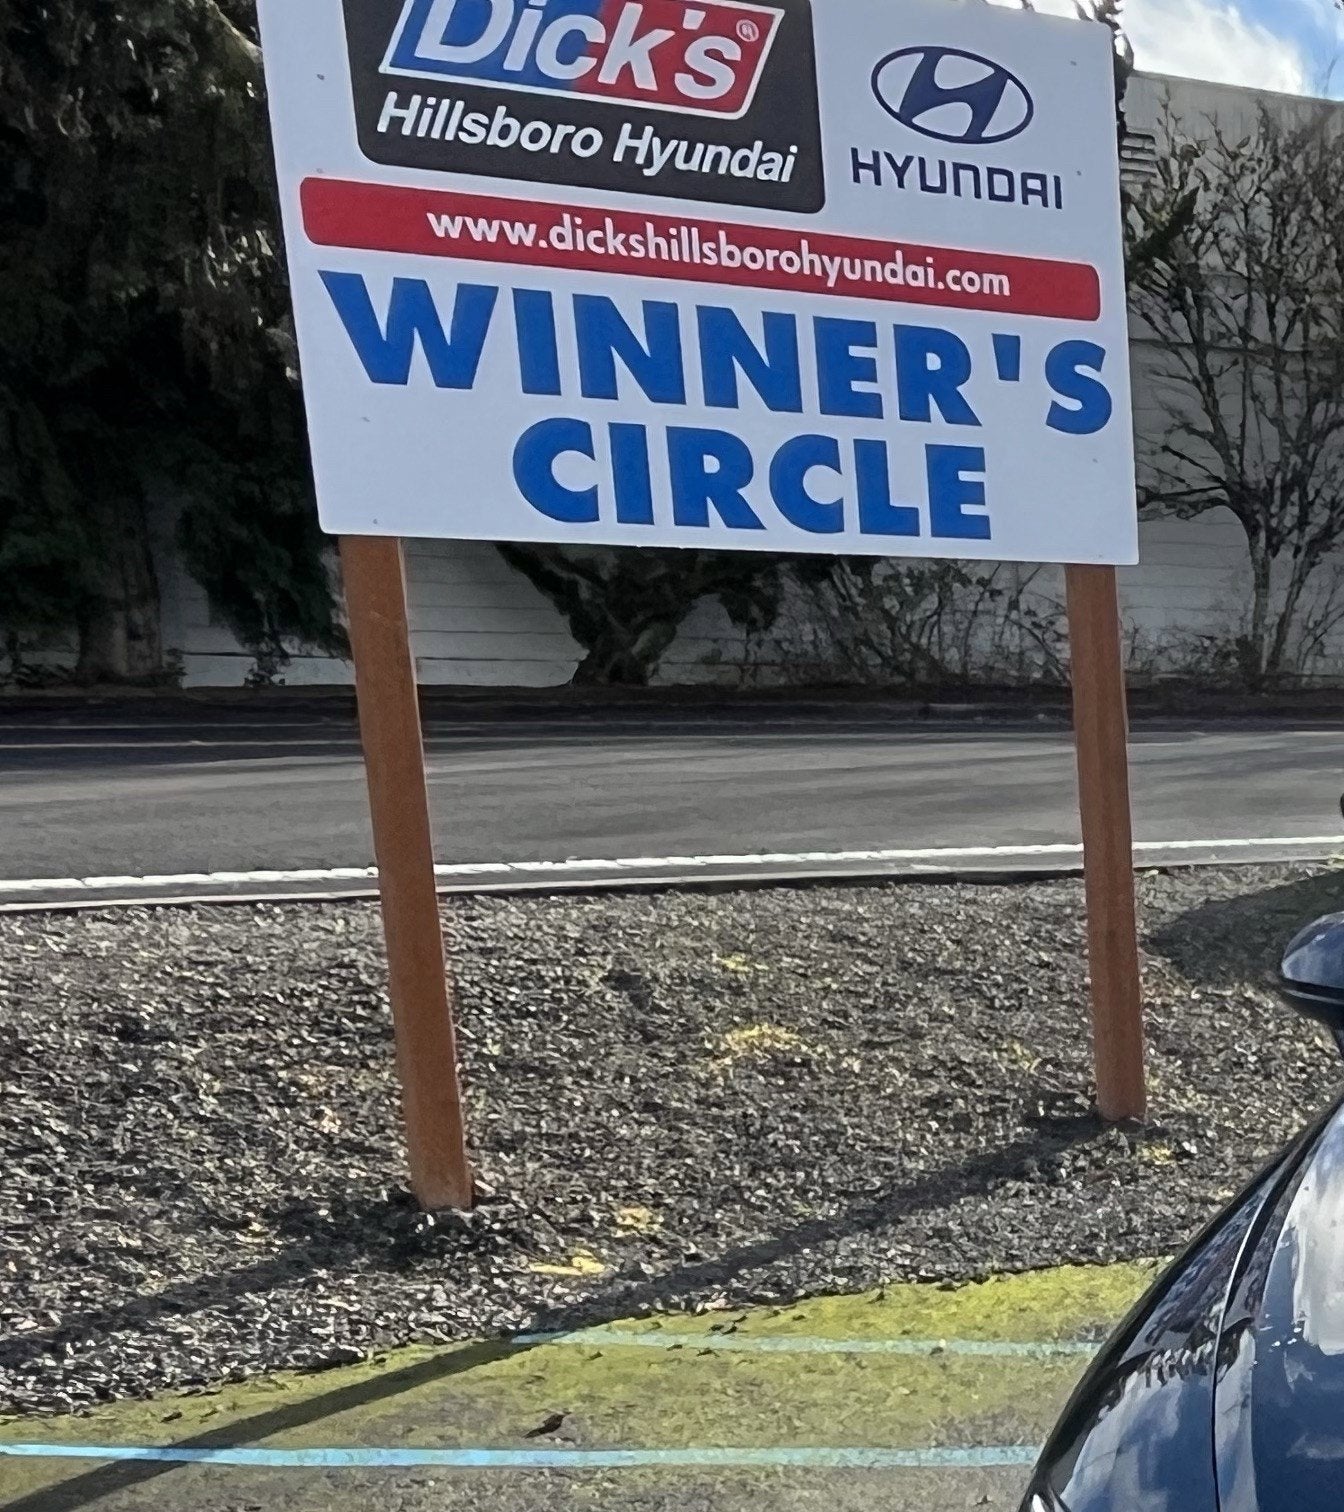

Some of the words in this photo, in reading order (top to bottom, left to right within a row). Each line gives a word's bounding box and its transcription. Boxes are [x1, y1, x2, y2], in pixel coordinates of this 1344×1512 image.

[413, 0, 742, 100] Dick's
[376, 91, 603, 158] Hillsboro
[612, 123, 798, 183] Hyundai
[850, 147, 1063, 210] HYUNDAI
[426, 212, 1011, 297] www.dickshillsborohyundai.com
[317, 269, 1113, 435] WINNER'S
[512, 417, 991, 540] CIRCLE
